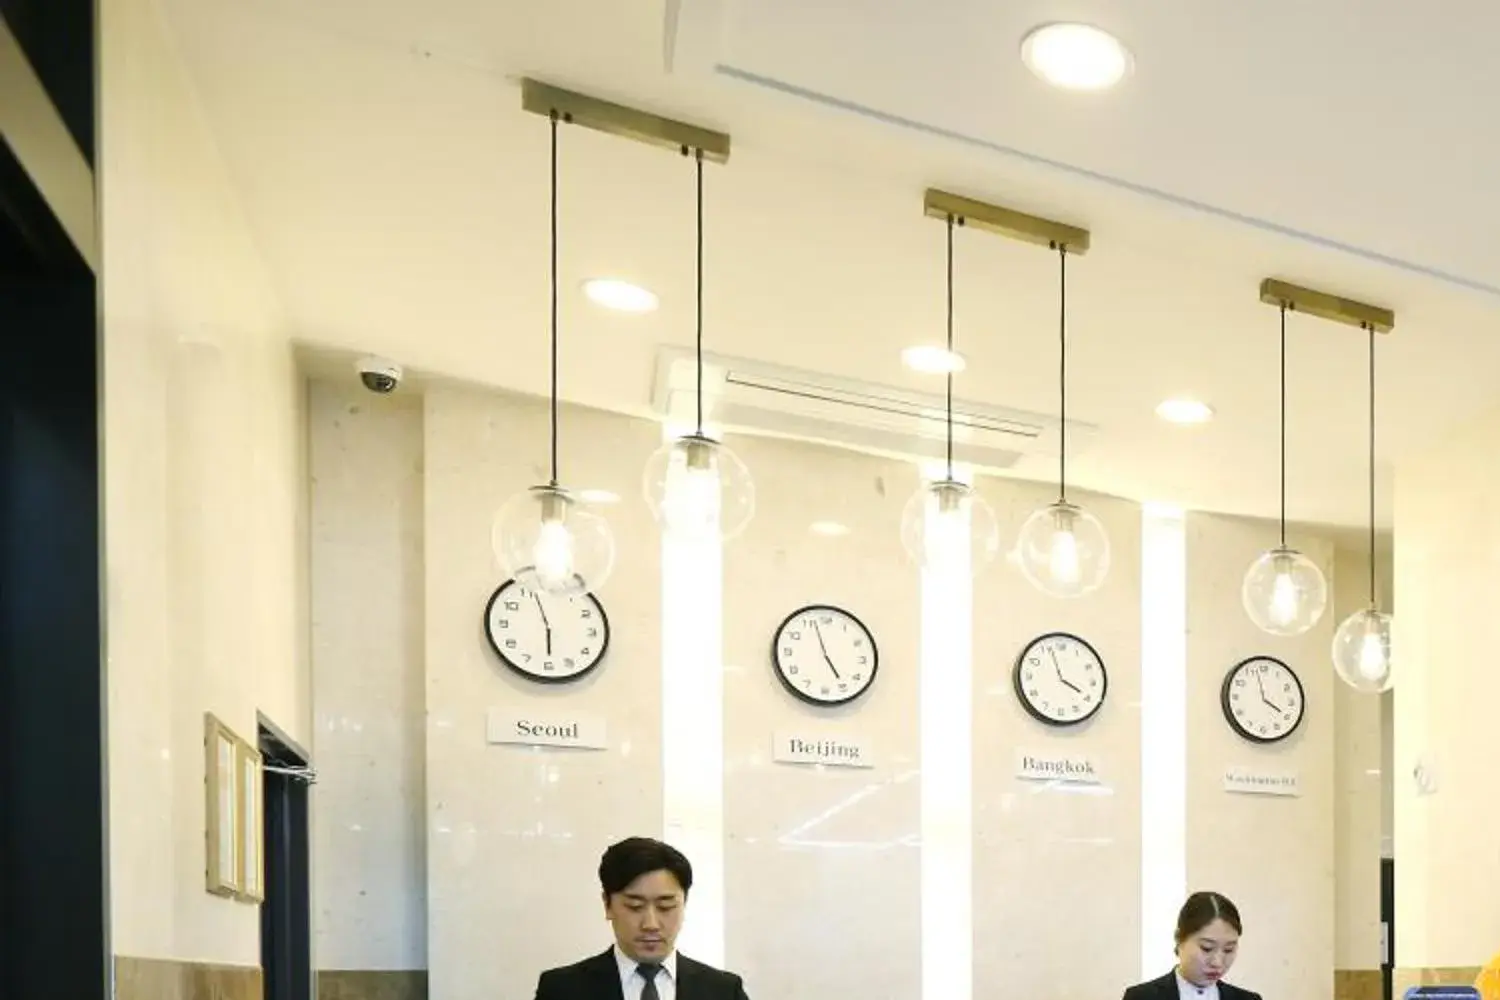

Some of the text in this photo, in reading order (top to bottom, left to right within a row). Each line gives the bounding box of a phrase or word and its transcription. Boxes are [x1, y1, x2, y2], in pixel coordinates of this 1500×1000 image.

[516, 719, 578, 738] Seoul
[790, 739, 860, 760] Beijing
[1022, 755, 1095, 774] Bangkok
